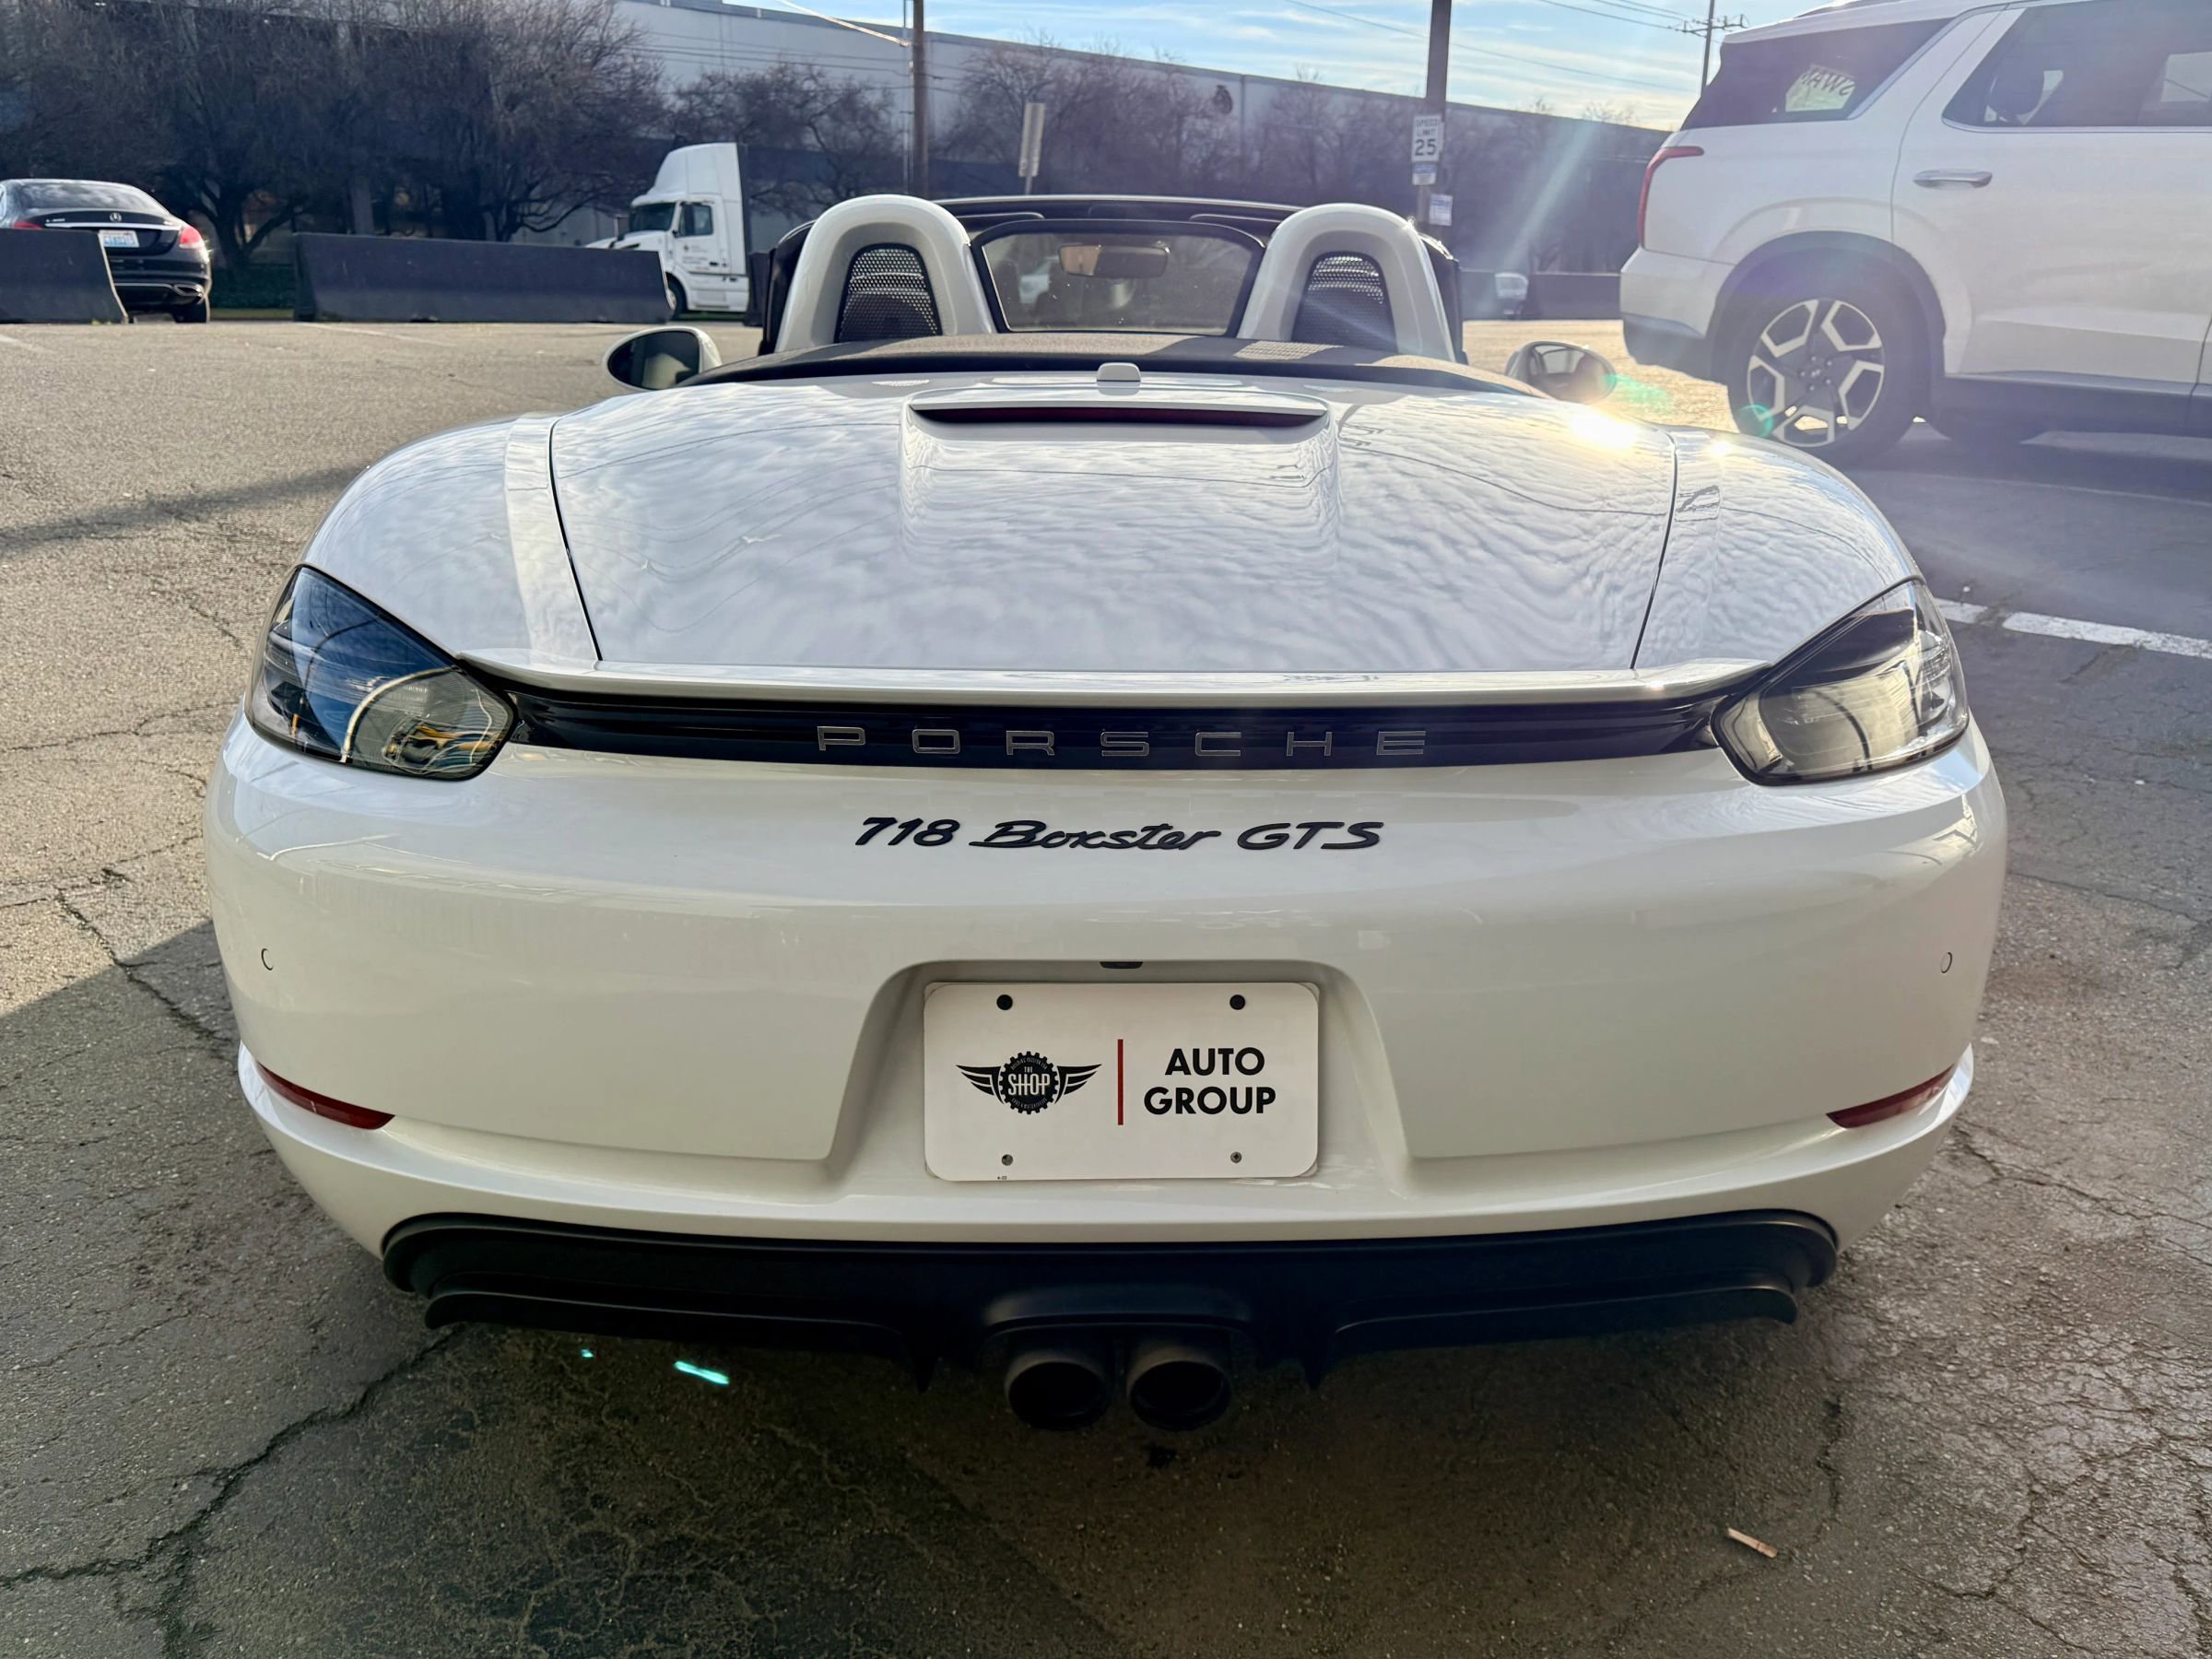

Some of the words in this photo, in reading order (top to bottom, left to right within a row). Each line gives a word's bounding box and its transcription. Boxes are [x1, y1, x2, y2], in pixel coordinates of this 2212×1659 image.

[1415, 138, 1437, 157] 25
[817, 725, 1427, 758] PORSCHE
[854, 817, 960, 846] 718
[969, 820, 1221, 851] Boxster
[1237, 821, 1384, 851] GTS
[1164, 1047, 1265, 1077] AUTO
[1007, 1073, 1051, 1096] SHOP
[1143, 1086, 1277, 1115] GROUP
